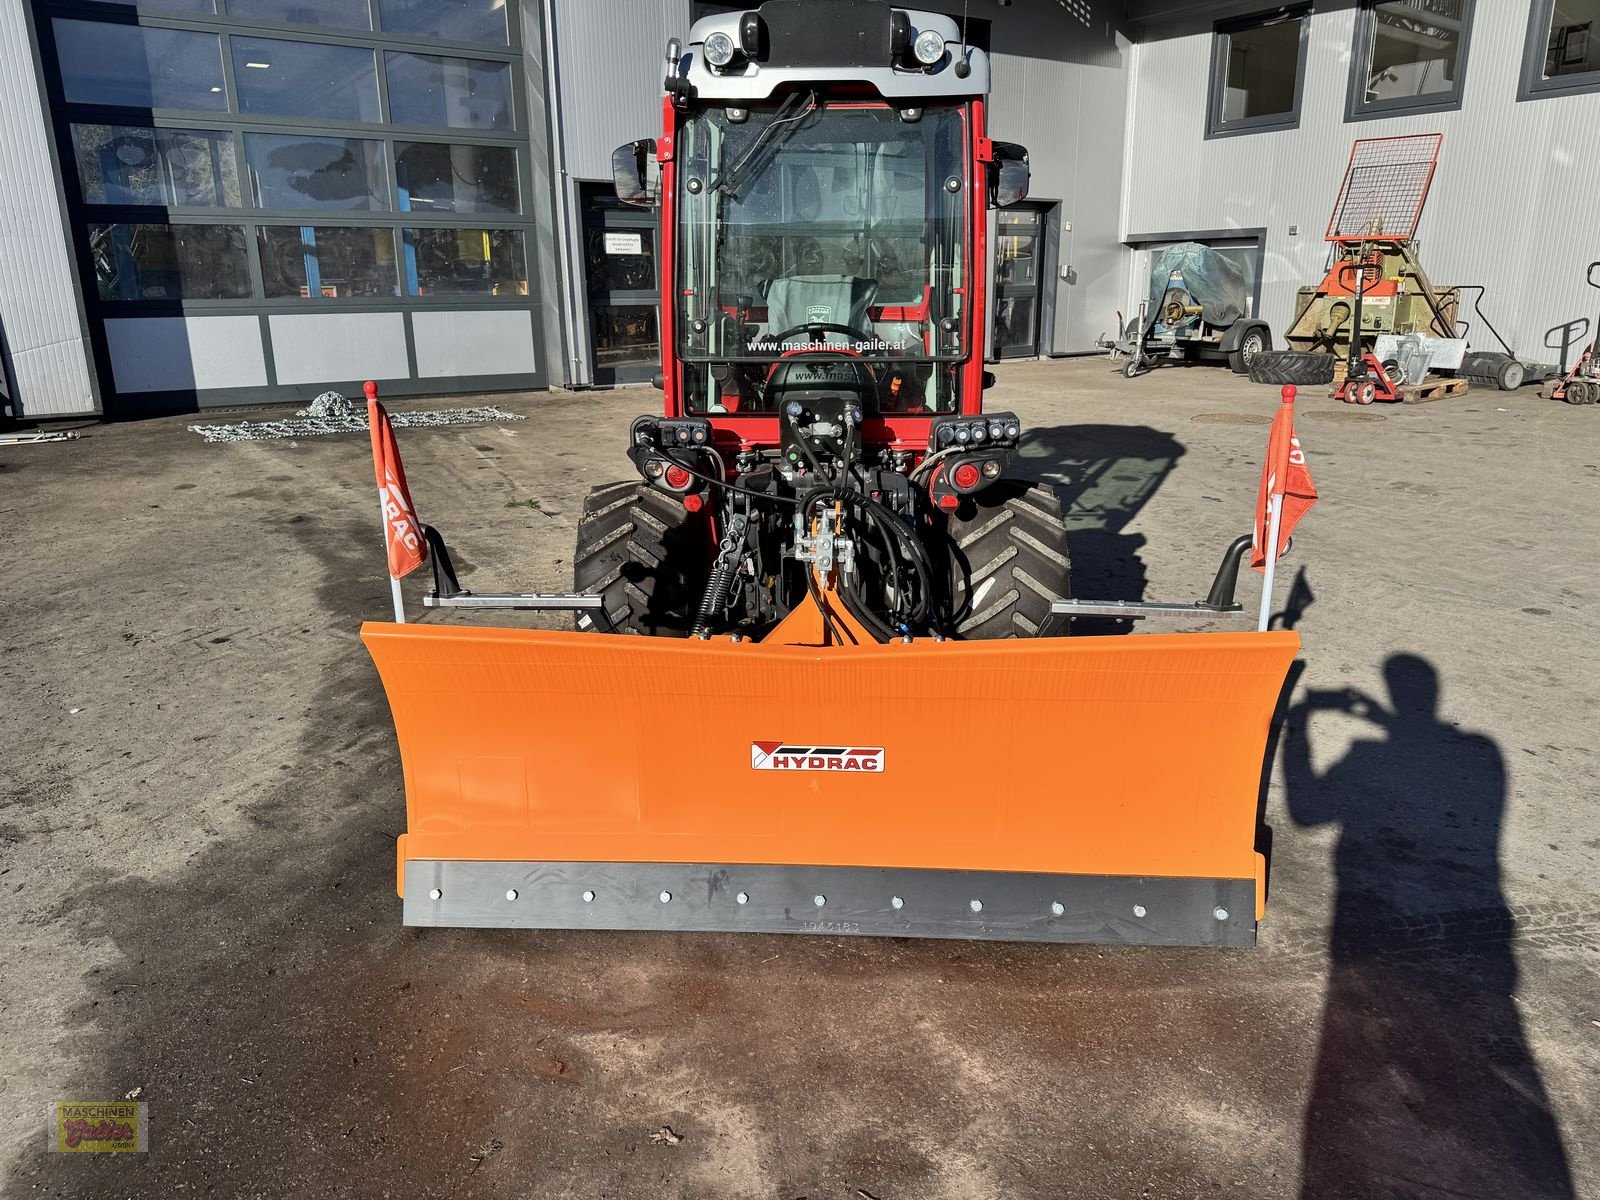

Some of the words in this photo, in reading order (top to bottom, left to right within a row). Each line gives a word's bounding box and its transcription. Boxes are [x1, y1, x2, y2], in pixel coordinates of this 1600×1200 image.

[747, 338, 905, 353] www.maschinen-gailer.at
[386, 490, 418, 550] RAC
[773, 756, 878, 770] HYDRAC
